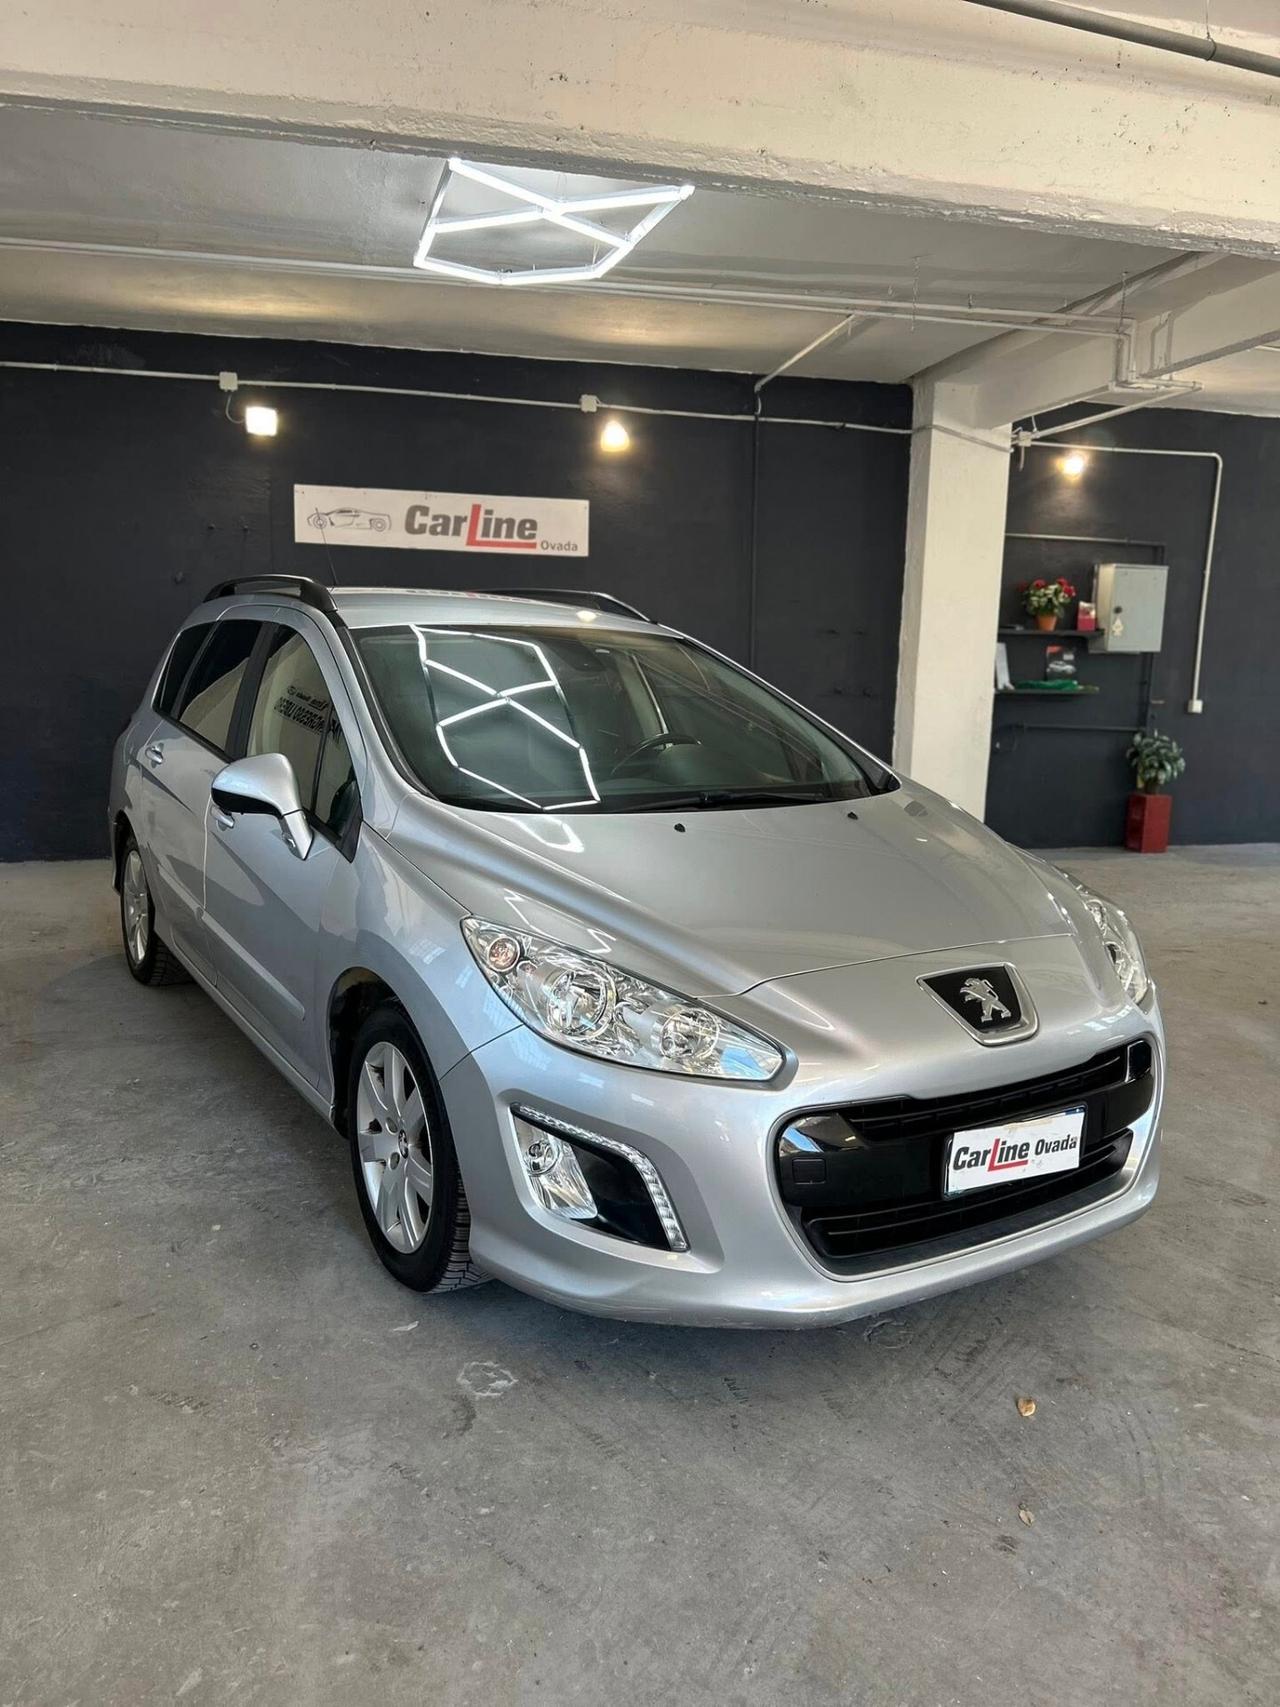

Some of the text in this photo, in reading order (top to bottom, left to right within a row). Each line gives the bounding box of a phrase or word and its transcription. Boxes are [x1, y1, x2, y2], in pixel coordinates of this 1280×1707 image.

[404, 504, 579, 552] CarLine Ovada
[953, 1135, 1077, 1172] CarLine Ovada
